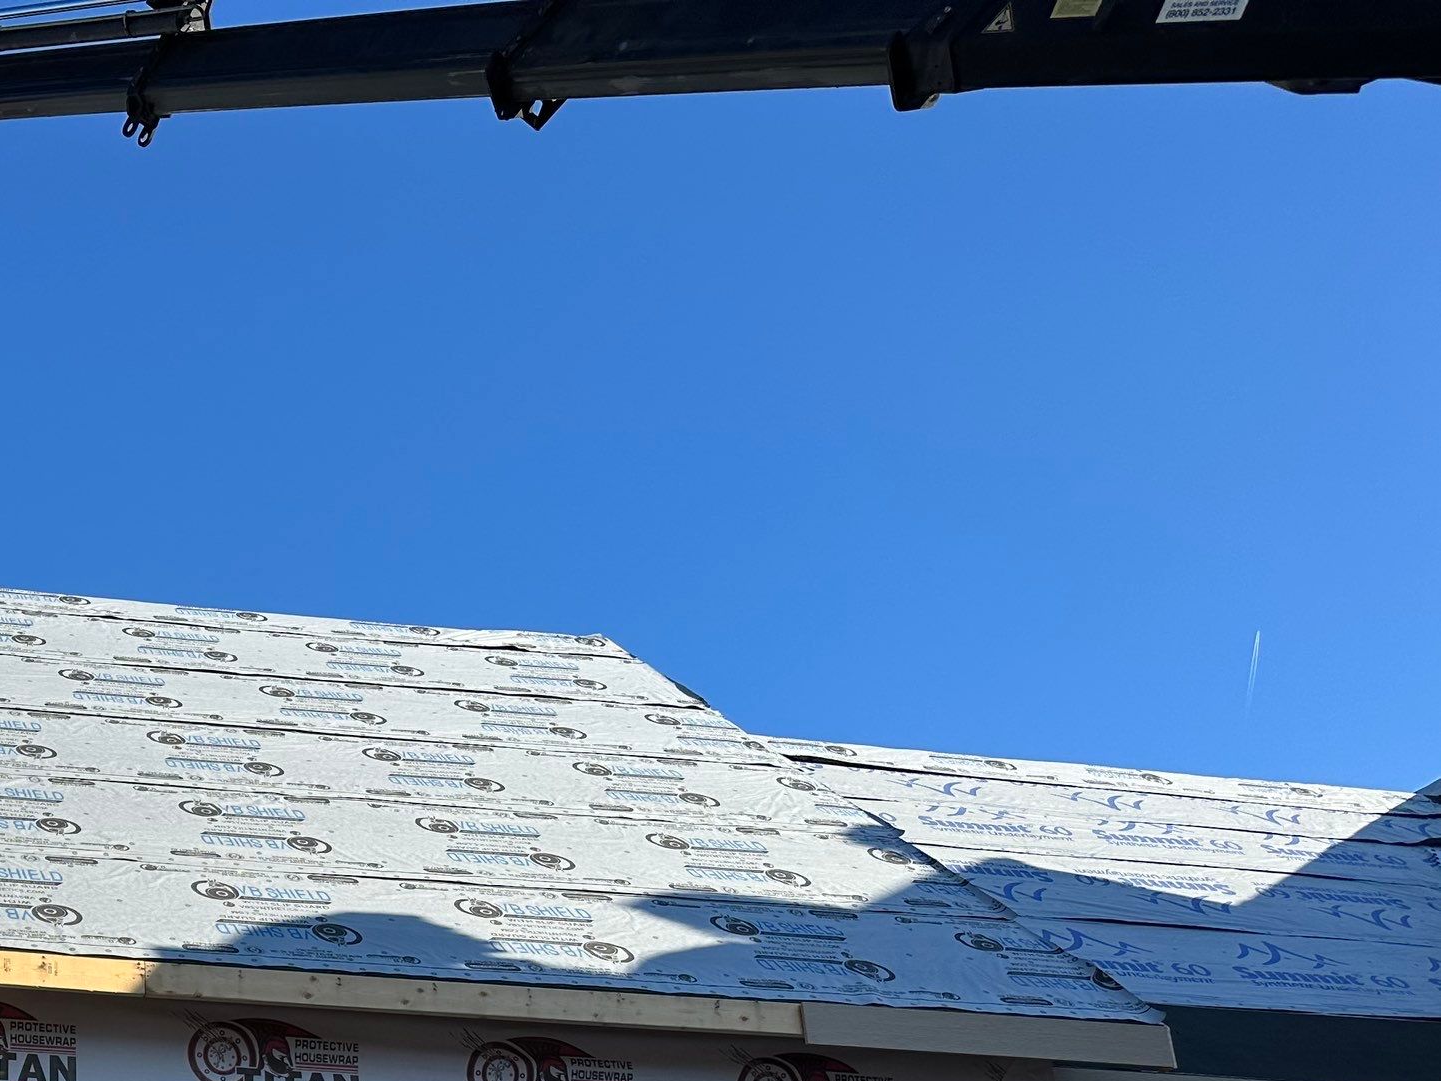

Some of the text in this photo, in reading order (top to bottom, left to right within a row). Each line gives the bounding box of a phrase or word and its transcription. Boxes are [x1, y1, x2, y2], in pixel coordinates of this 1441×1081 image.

[918, 815, 1073, 837] Summit 60
[1093, 828, 1243, 851] Summit 60
[269, 888, 331, 901] SHIELD
[782, 921, 844, 936] SHIELD
[1233, 965, 1410, 989] Summit 60
[10, 1021, 76, 1034] PROTECTIVE
[10, 1034, 76, 1047] HOUSEWRAP
[570, 1057, 633, 1070] PROTECTIVE
